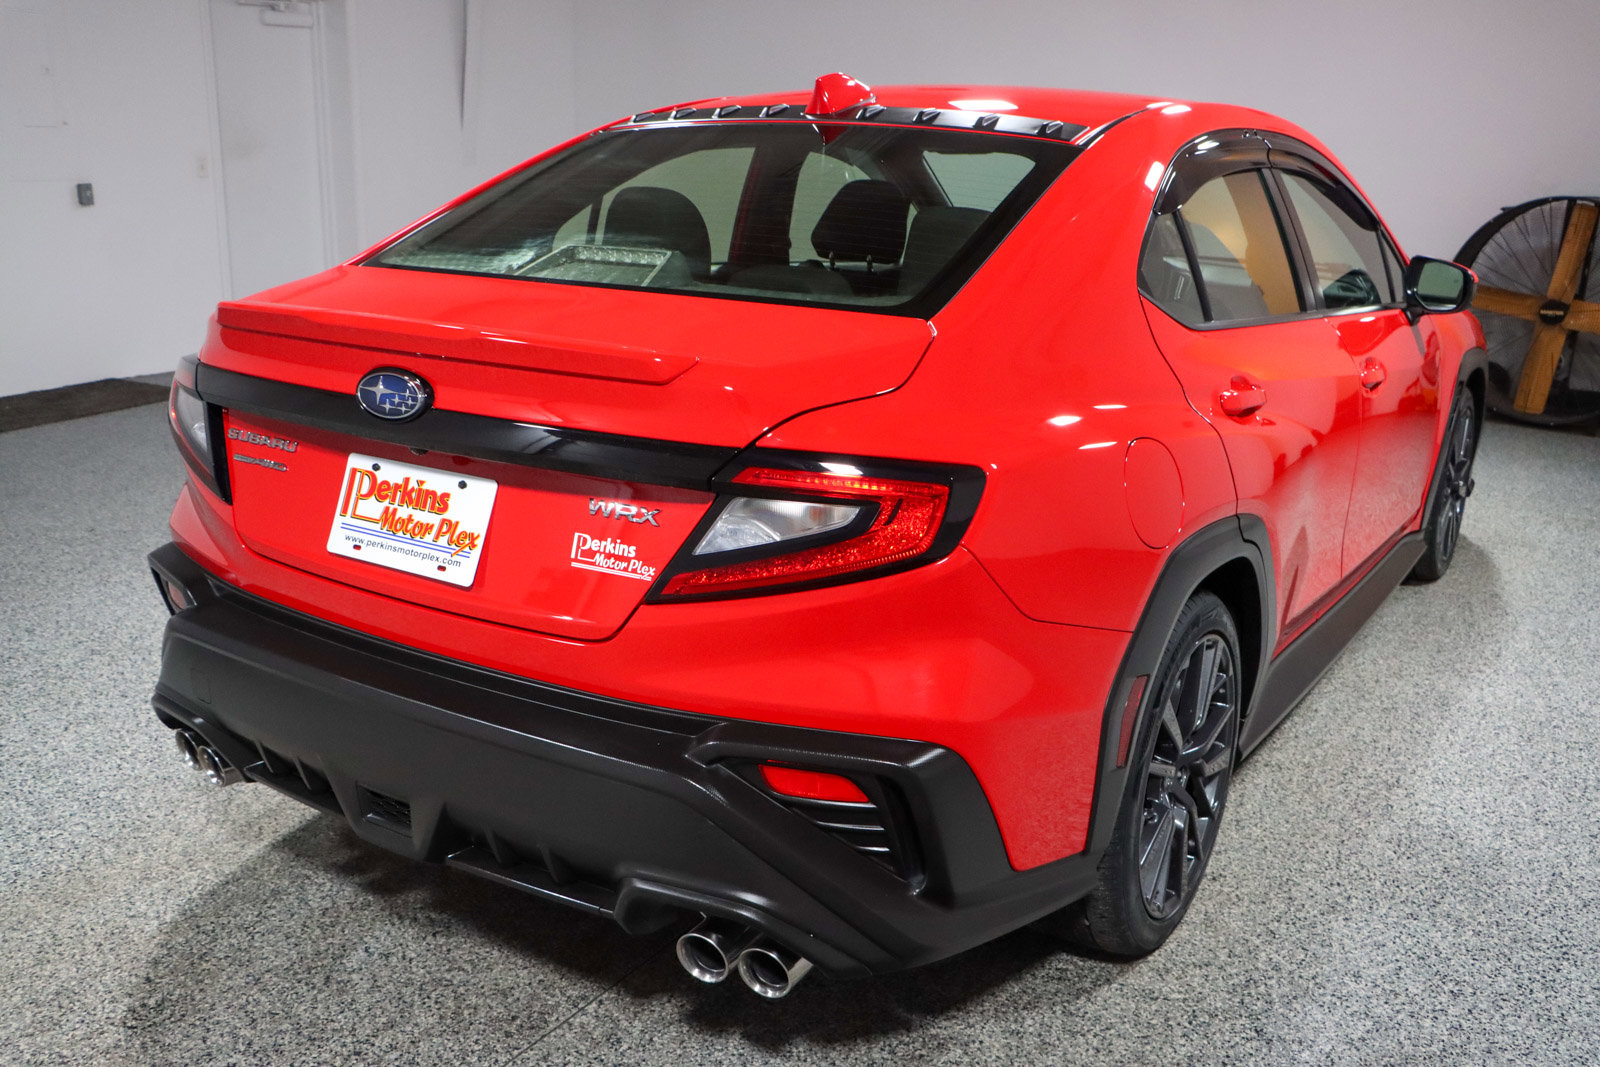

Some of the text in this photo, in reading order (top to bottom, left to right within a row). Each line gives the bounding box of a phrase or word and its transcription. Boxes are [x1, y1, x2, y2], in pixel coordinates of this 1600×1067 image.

[227, 428, 299, 453] SUBARU
[340, 467, 451, 521] Perkins
[588, 498, 661, 527] WRX
[379, 506, 480, 557] Motor Plex
[344, 534, 462, 568] www.perkinsmotorplex.com
[571, 532, 637, 561] Perkins
[594, 553, 656, 579] Motor Plex
